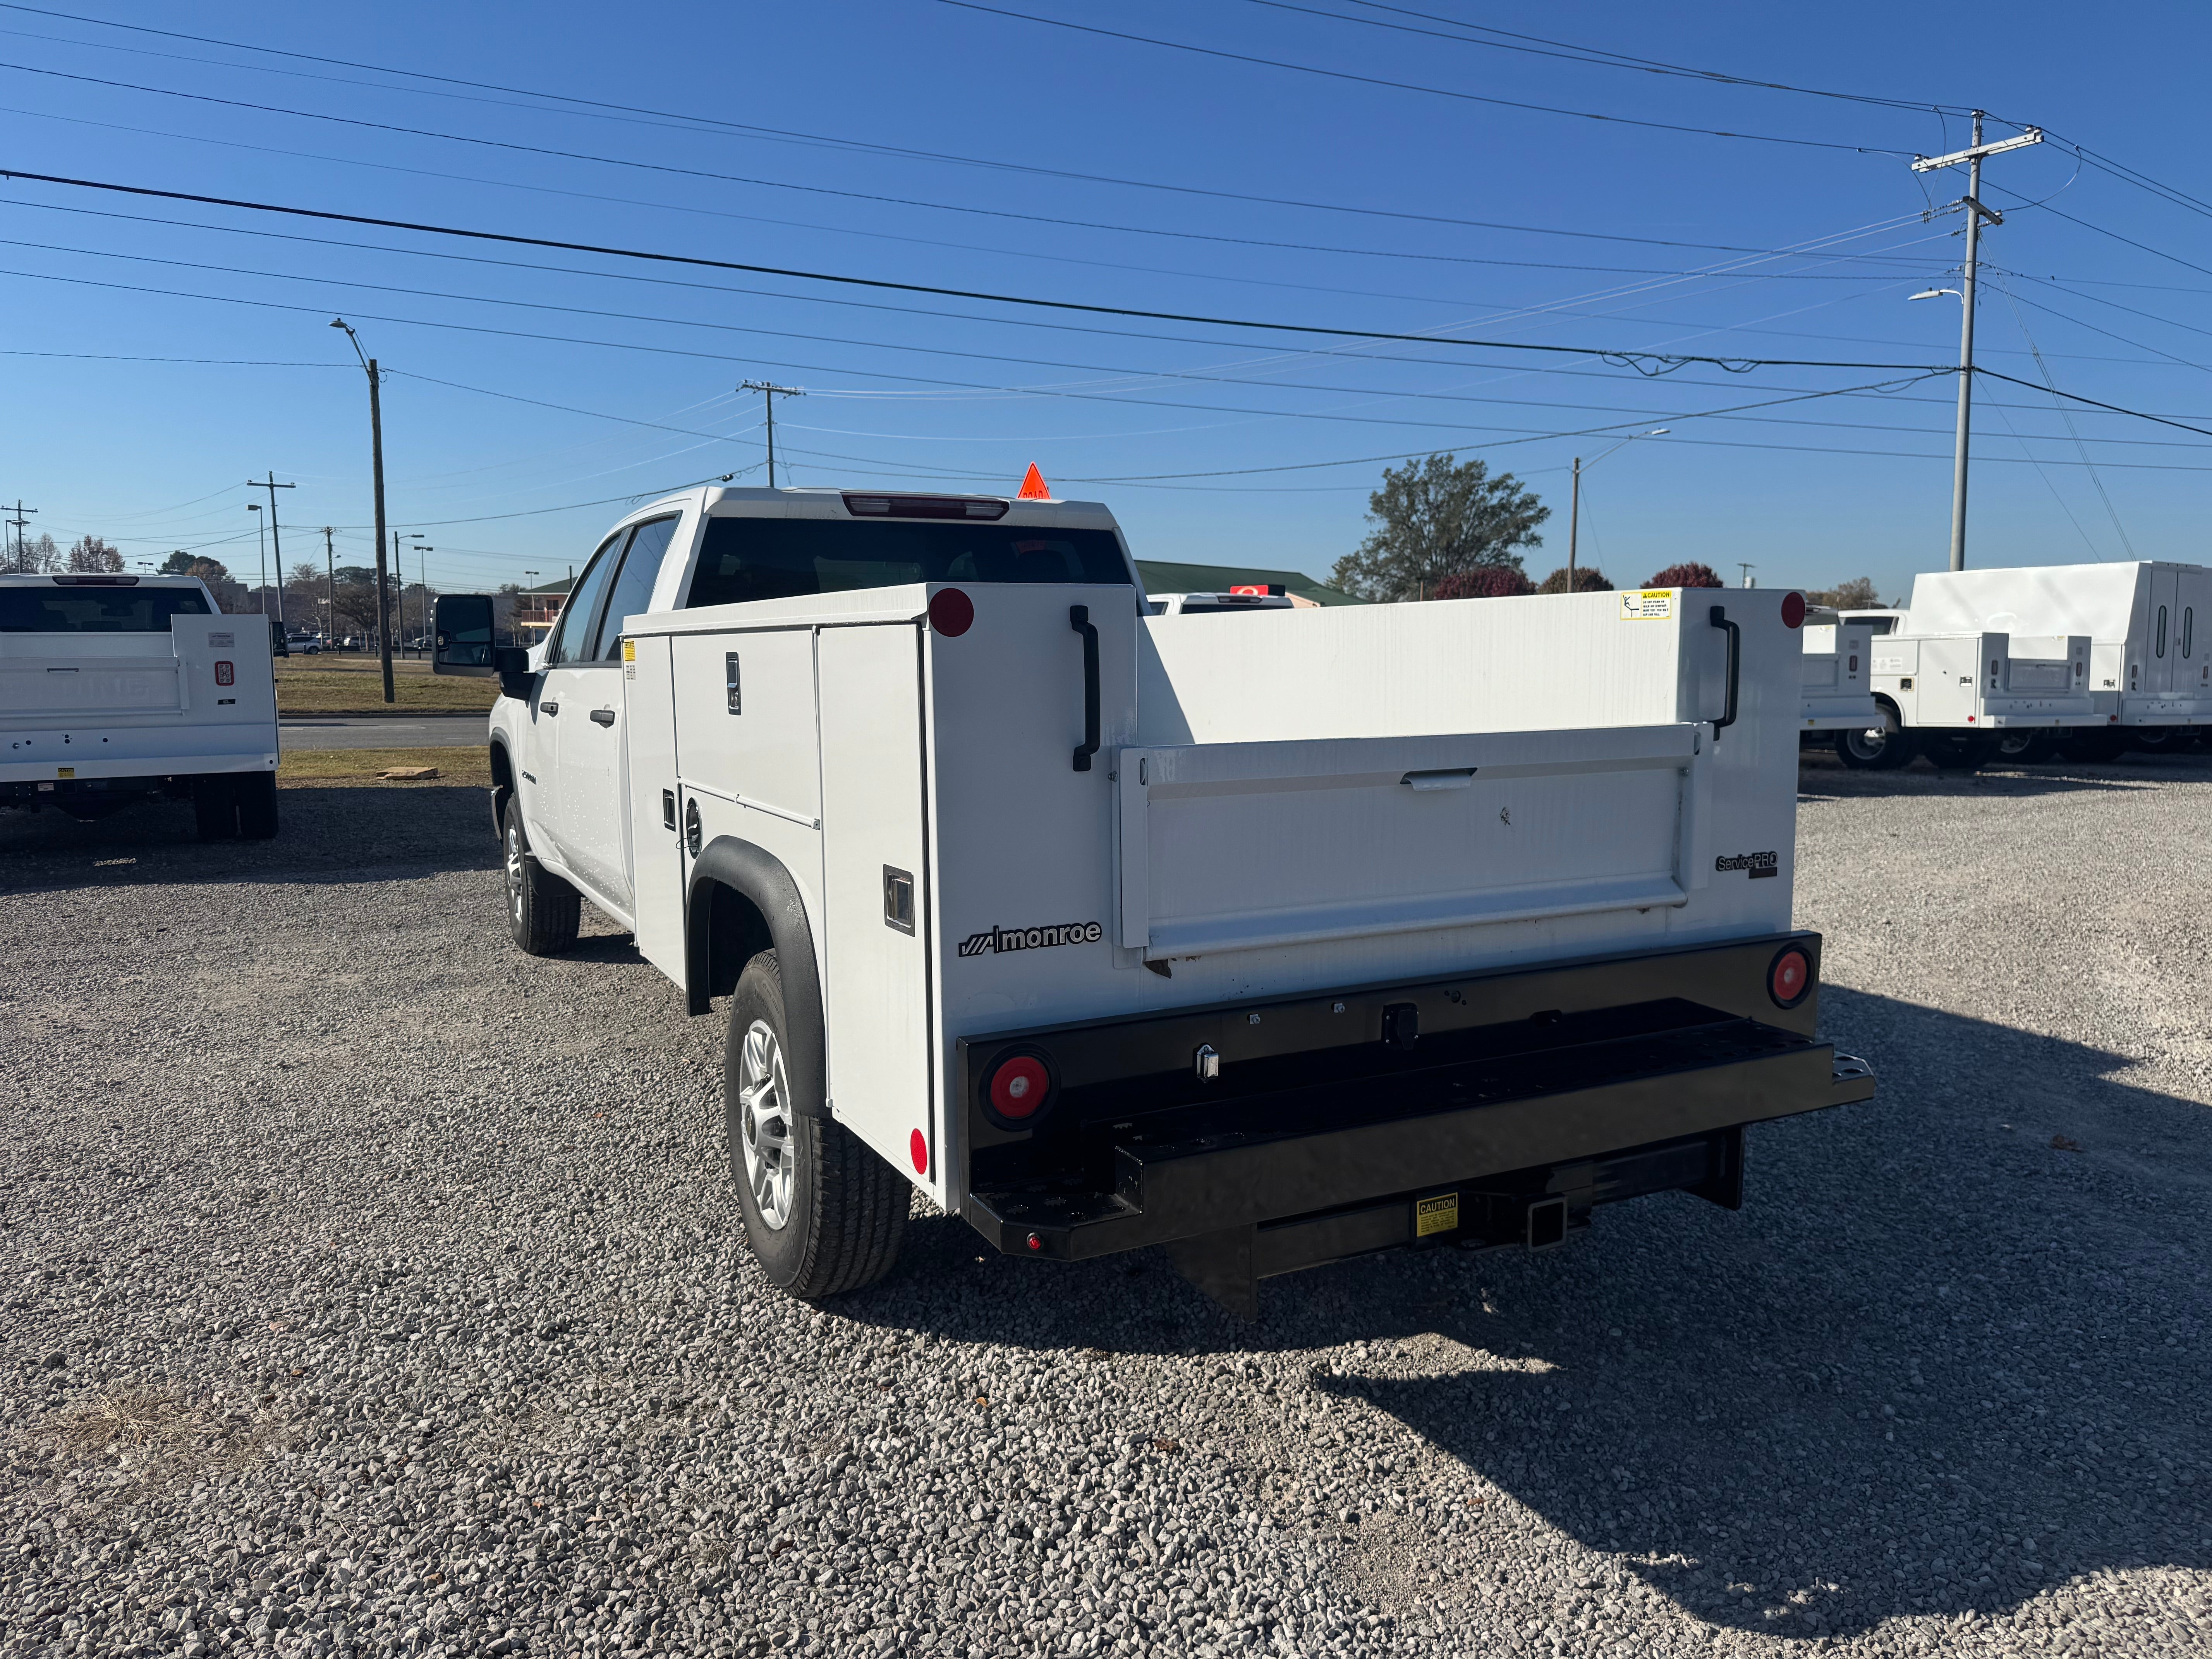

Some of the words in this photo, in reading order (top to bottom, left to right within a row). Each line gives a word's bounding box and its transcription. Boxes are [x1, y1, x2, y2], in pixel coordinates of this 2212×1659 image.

[1717, 852, 1778, 871] ServicePRO
[1001, 922, 1101, 952] monroe
[1420, 1198, 1455, 1214] CAUTION
